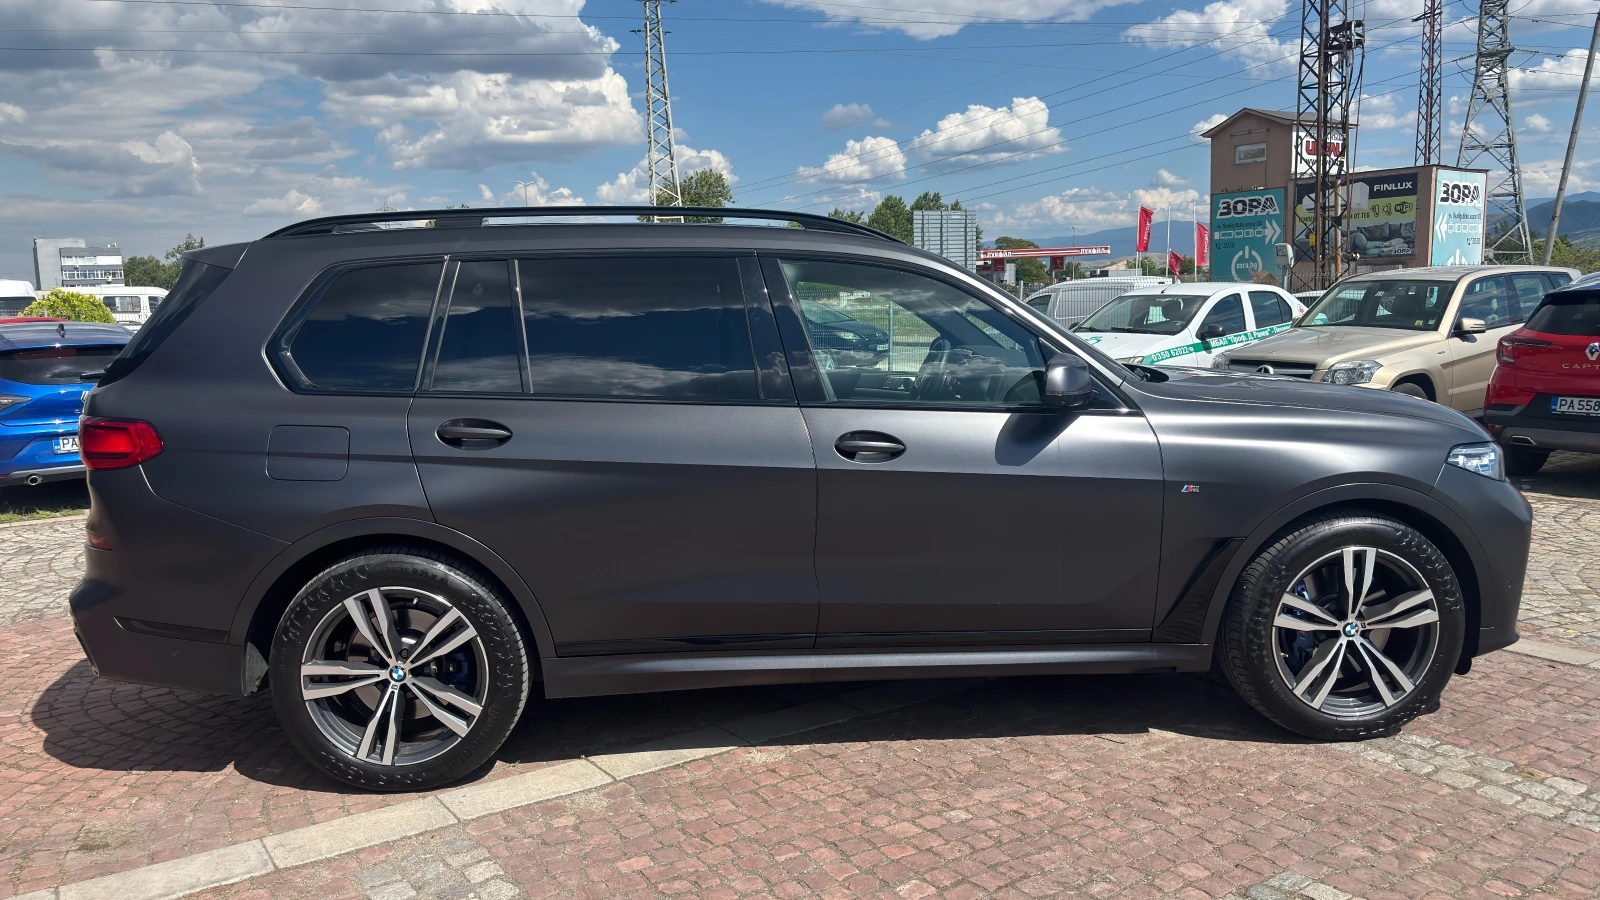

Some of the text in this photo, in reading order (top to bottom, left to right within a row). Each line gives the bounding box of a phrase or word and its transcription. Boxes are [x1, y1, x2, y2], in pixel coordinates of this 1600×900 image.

[1373, 181, 1413, 192] FINLUX
[1439, 181, 1482, 206] ЗОРА
[1217, 196, 1279, 218] ЗОРА
[1236, 261, 1258, 270] zora.bg
[1151, 350, 1170, 362] 0350
[1559, 399, 1574, 410] PA
[61, 437, 79, 449] PA
